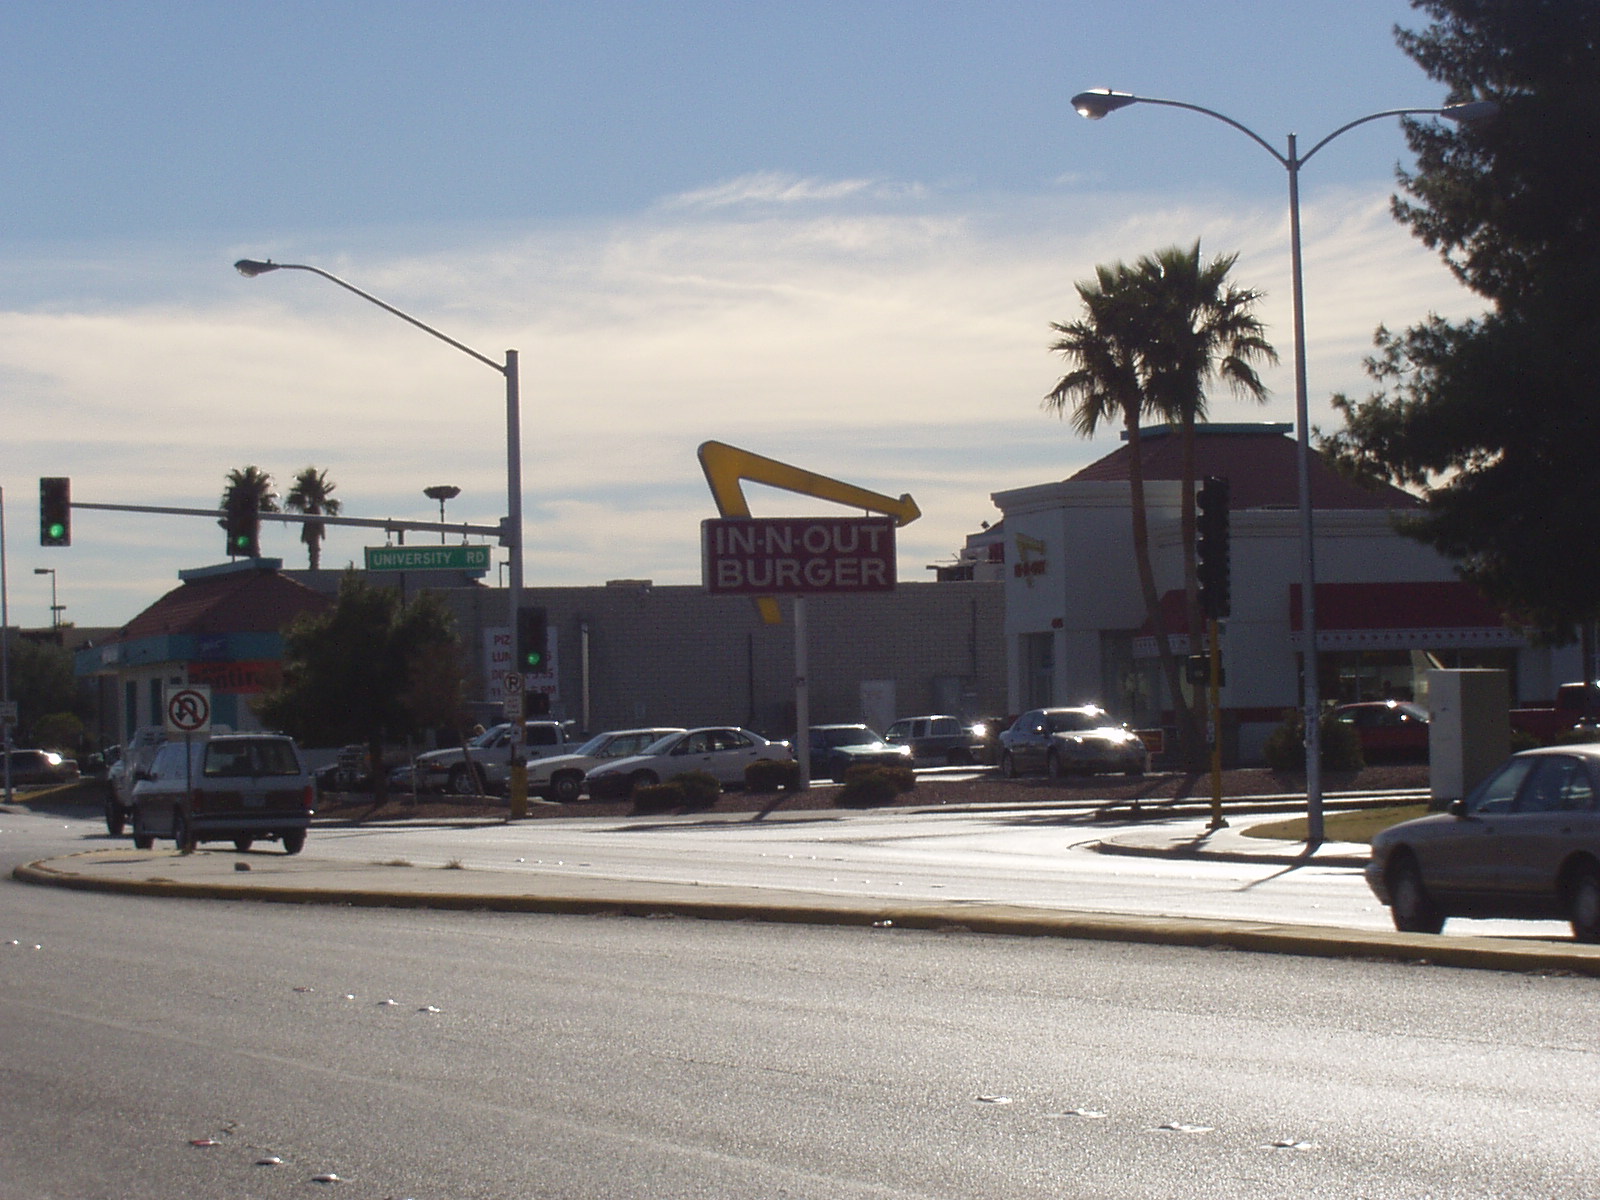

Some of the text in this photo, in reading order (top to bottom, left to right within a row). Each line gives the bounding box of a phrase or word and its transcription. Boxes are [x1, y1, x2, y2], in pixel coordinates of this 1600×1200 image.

[374, 551, 484, 566] UNIVERSITY RD
[717, 558, 888, 587] BURGER
